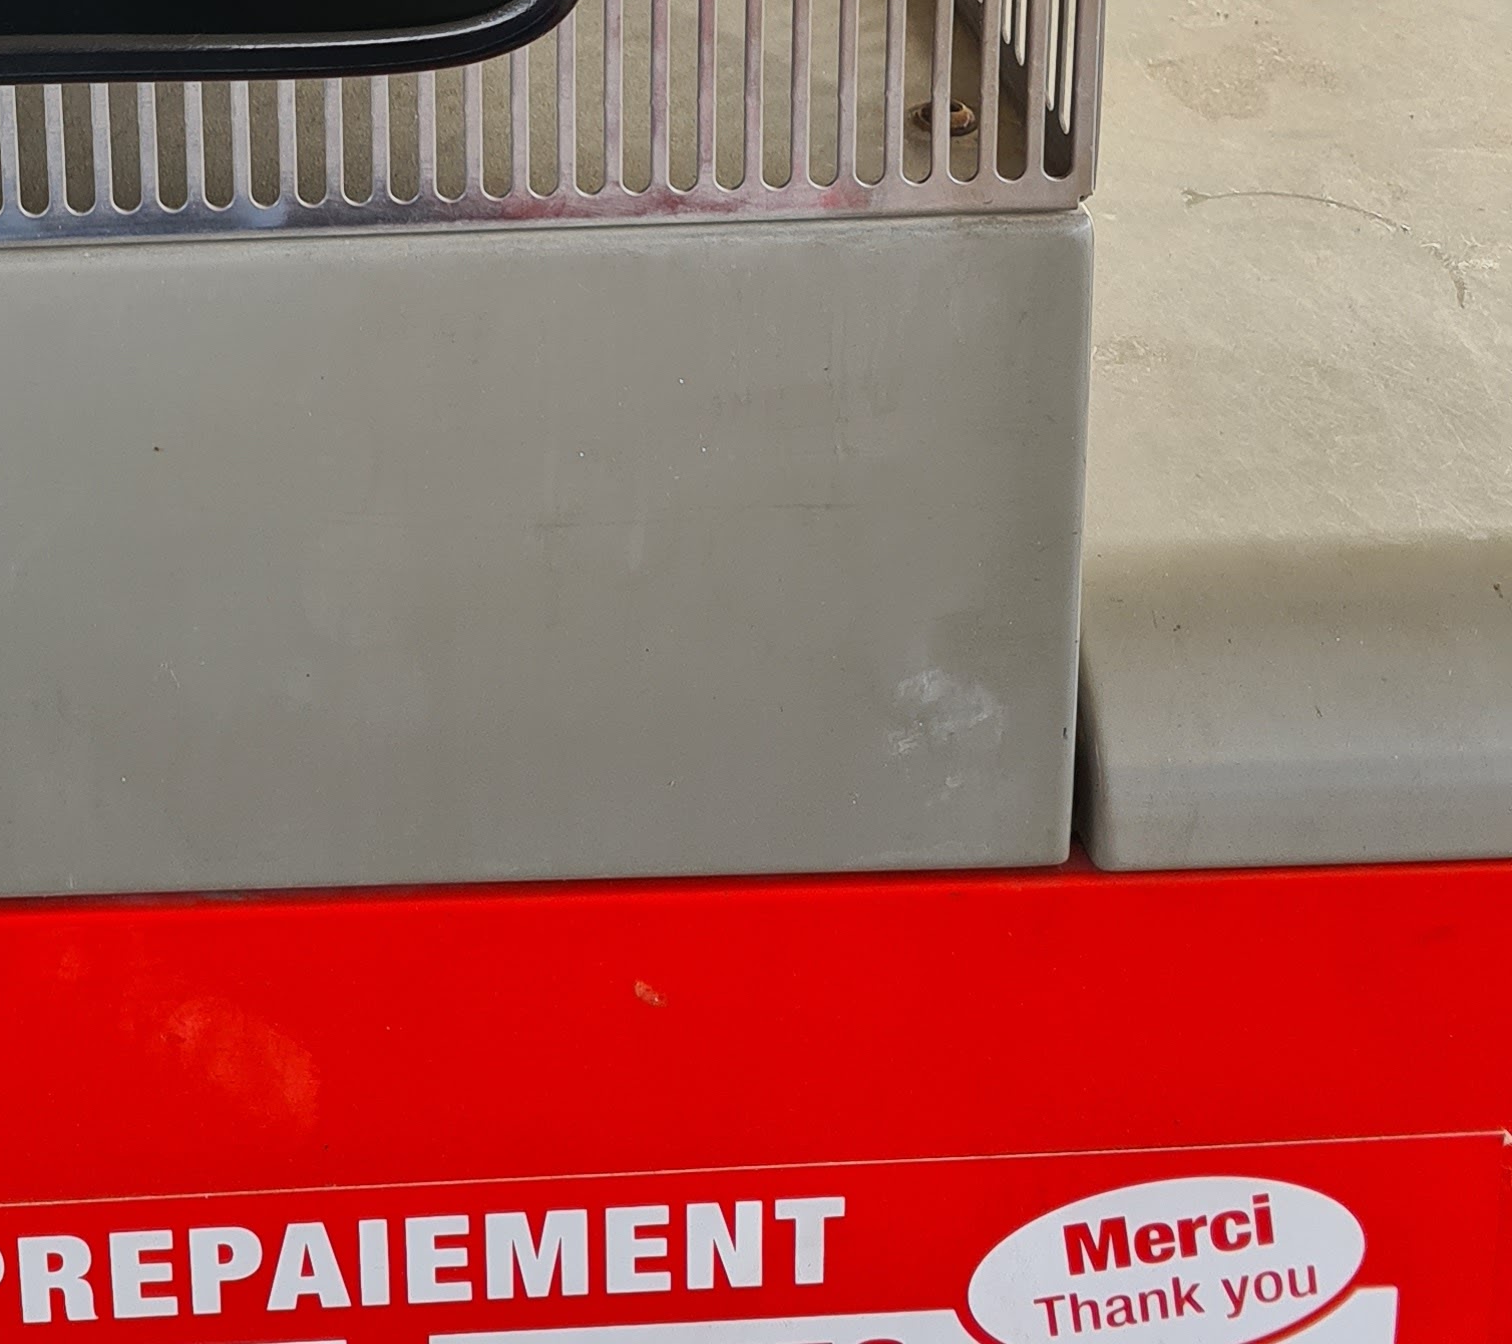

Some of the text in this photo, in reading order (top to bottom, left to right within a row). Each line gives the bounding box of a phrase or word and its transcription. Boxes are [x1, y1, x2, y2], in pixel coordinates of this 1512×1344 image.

[1063, 1193, 1275, 1275] Merci
[1034, 1264, 1319, 1337] Thank you
